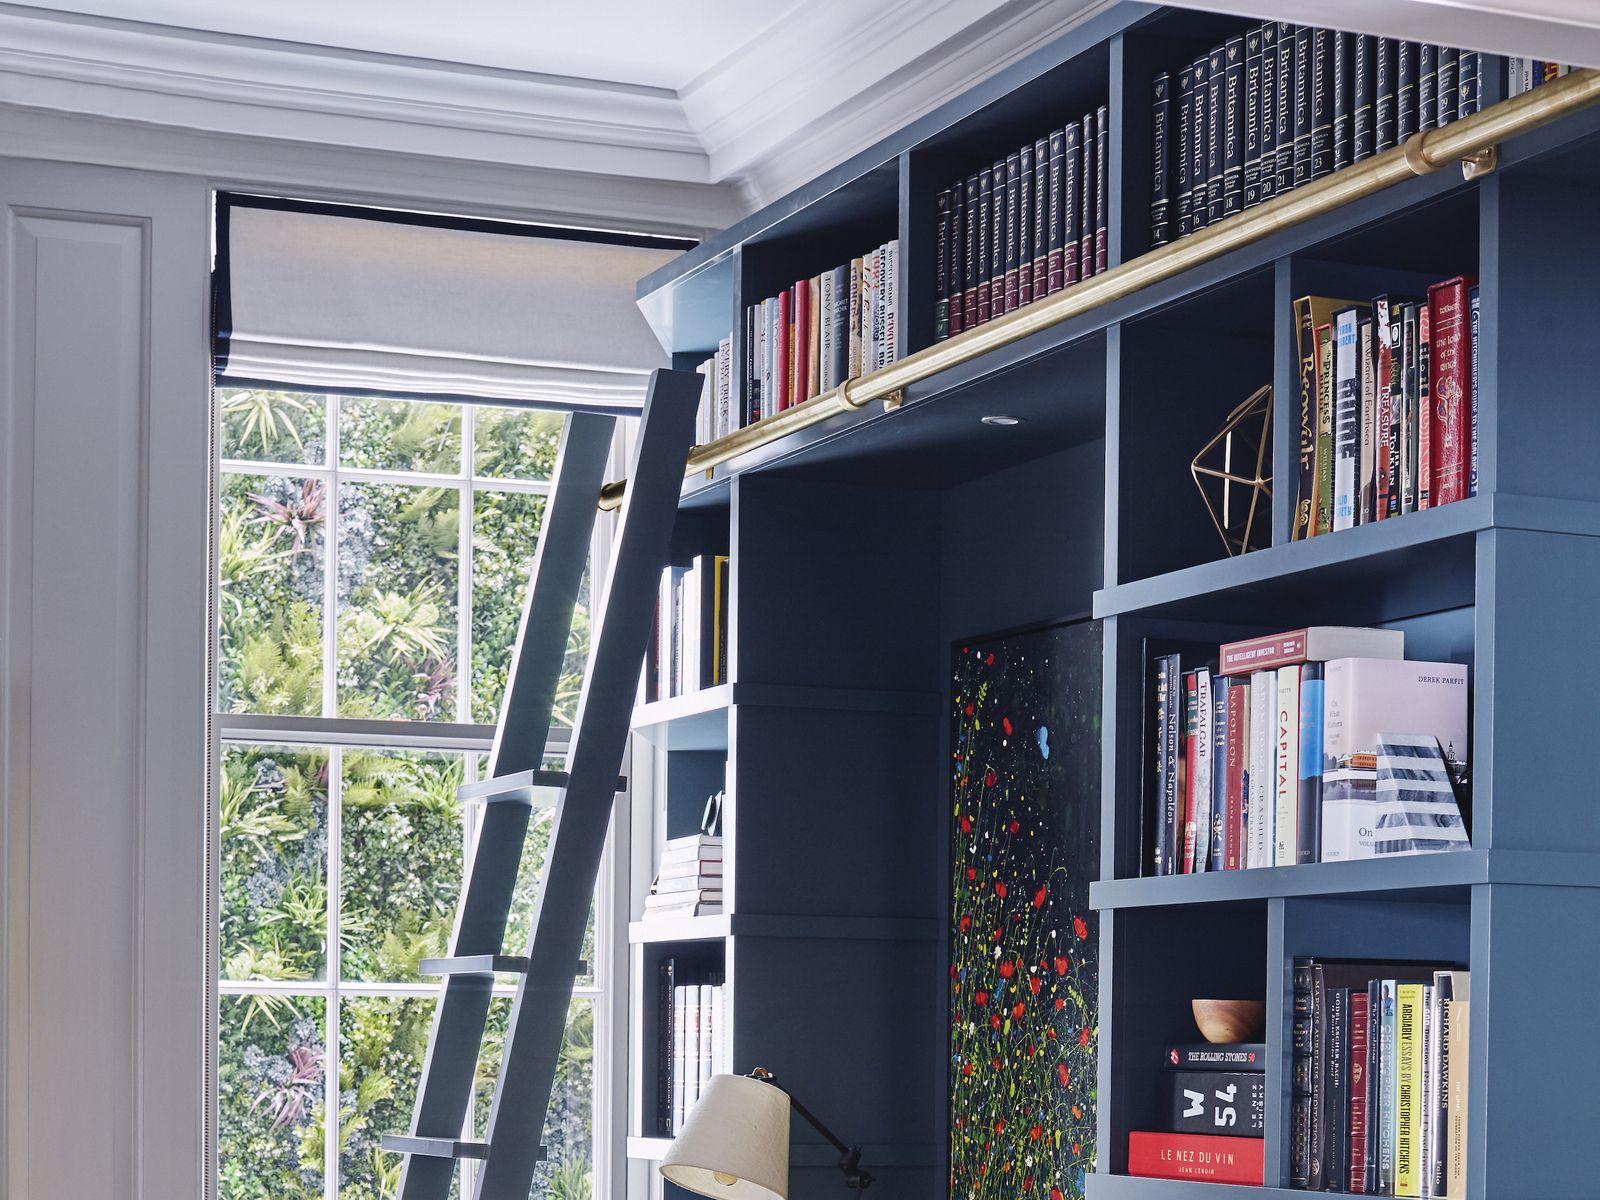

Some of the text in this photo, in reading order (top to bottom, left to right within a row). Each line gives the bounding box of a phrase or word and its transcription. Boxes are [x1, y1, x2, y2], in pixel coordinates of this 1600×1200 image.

[1264, 57, 1274, 142] Britannica
[1280, 48, 1290, 135] Britannica
[1298, 39, 1307, 126] Britannica
[1316, 30, 1325, 117] Britannica
[1194, 94, 1204, 176] Britannica
[1209, 85, 1218, 168] Britannica
[1226, 75, 1237, 159] Britannica
[1248, 66, 1259, 151] Britannica
[1154, 111, 1164, 192] Britannica
[1180, 104, 1189, 184] Britannica
[1314, 157, 1322, 168] 23
[1066, 158, 1075, 234] Britannica
[1247, 190, 1255, 201] 19
[1262, 182, 1271, 193] 20
[1278, 175, 1285, 186] 21
[1296, 166, 1304, 177] 22
[1007, 188, 1016, 262] Britannica
[1020, 182, 1029, 256] Britannica
[1035, 174, 1044, 249] Britannica
[1050, 166, 1060, 241] Britannica
[1193, 215, 1200, 225] 16
[1208, 206, 1215, 217] 17
[1226, 198, 1233, 208] 18
[966, 209, 974, 280] Britannica
[979, 202, 987, 274] Britannica
[993, 195, 1001, 268] Britannica
[823, 316, 831, 350] BLAIR
[722, 382, 730, 417] TRICK
[1322, 360, 1331, 425] PRINCESS
[1365, 387, 1372, 398] of
[1380, 383, 1391, 447] TREASURE
[1364, 399, 1373, 446] Earthsea
[1389, 432, 1397, 486] TOLKIEN
[1226, 654, 1234, 663] THE
[1234, 650, 1257, 661] INTELLIGENT
[1257, 646, 1275, 657] INVESTOR
[1418, 675, 1465, 685] DEREK PARFIT
[1168, 713, 1176, 752] Nelson
[1229, 690, 1237, 767] NAPOLEON
[1279, 710, 1288, 798] CAPITAL
[1168, 755, 1176, 768] &
[1166, 772, 1175, 824] Napoléon
[1359, 827, 1373, 837] On
[1188, 1052, 1199, 1061] THE
[1199, 1052, 1224, 1062] ROLLING
[1224, 1052, 1248, 1062] STONES
[1441, 1055, 1449, 1109] DAWKINS
[1183, 1089, 1205, 1118] W
[1214, 1083, 1237, 1127] 54
[1399, 1003, 1413, 1175] ARGUABLY ESSAYS BY CHRISTOPHER HITCHENS
[1251, 1113, 1257, 1128] LE
[1382, 1111, 1391, 1170] HITCHENS
[1161, 1149, 1234, 1165] LE NEZ DU VIN
[1178, 1166, 1215, 1175] JEAN LENOIR
